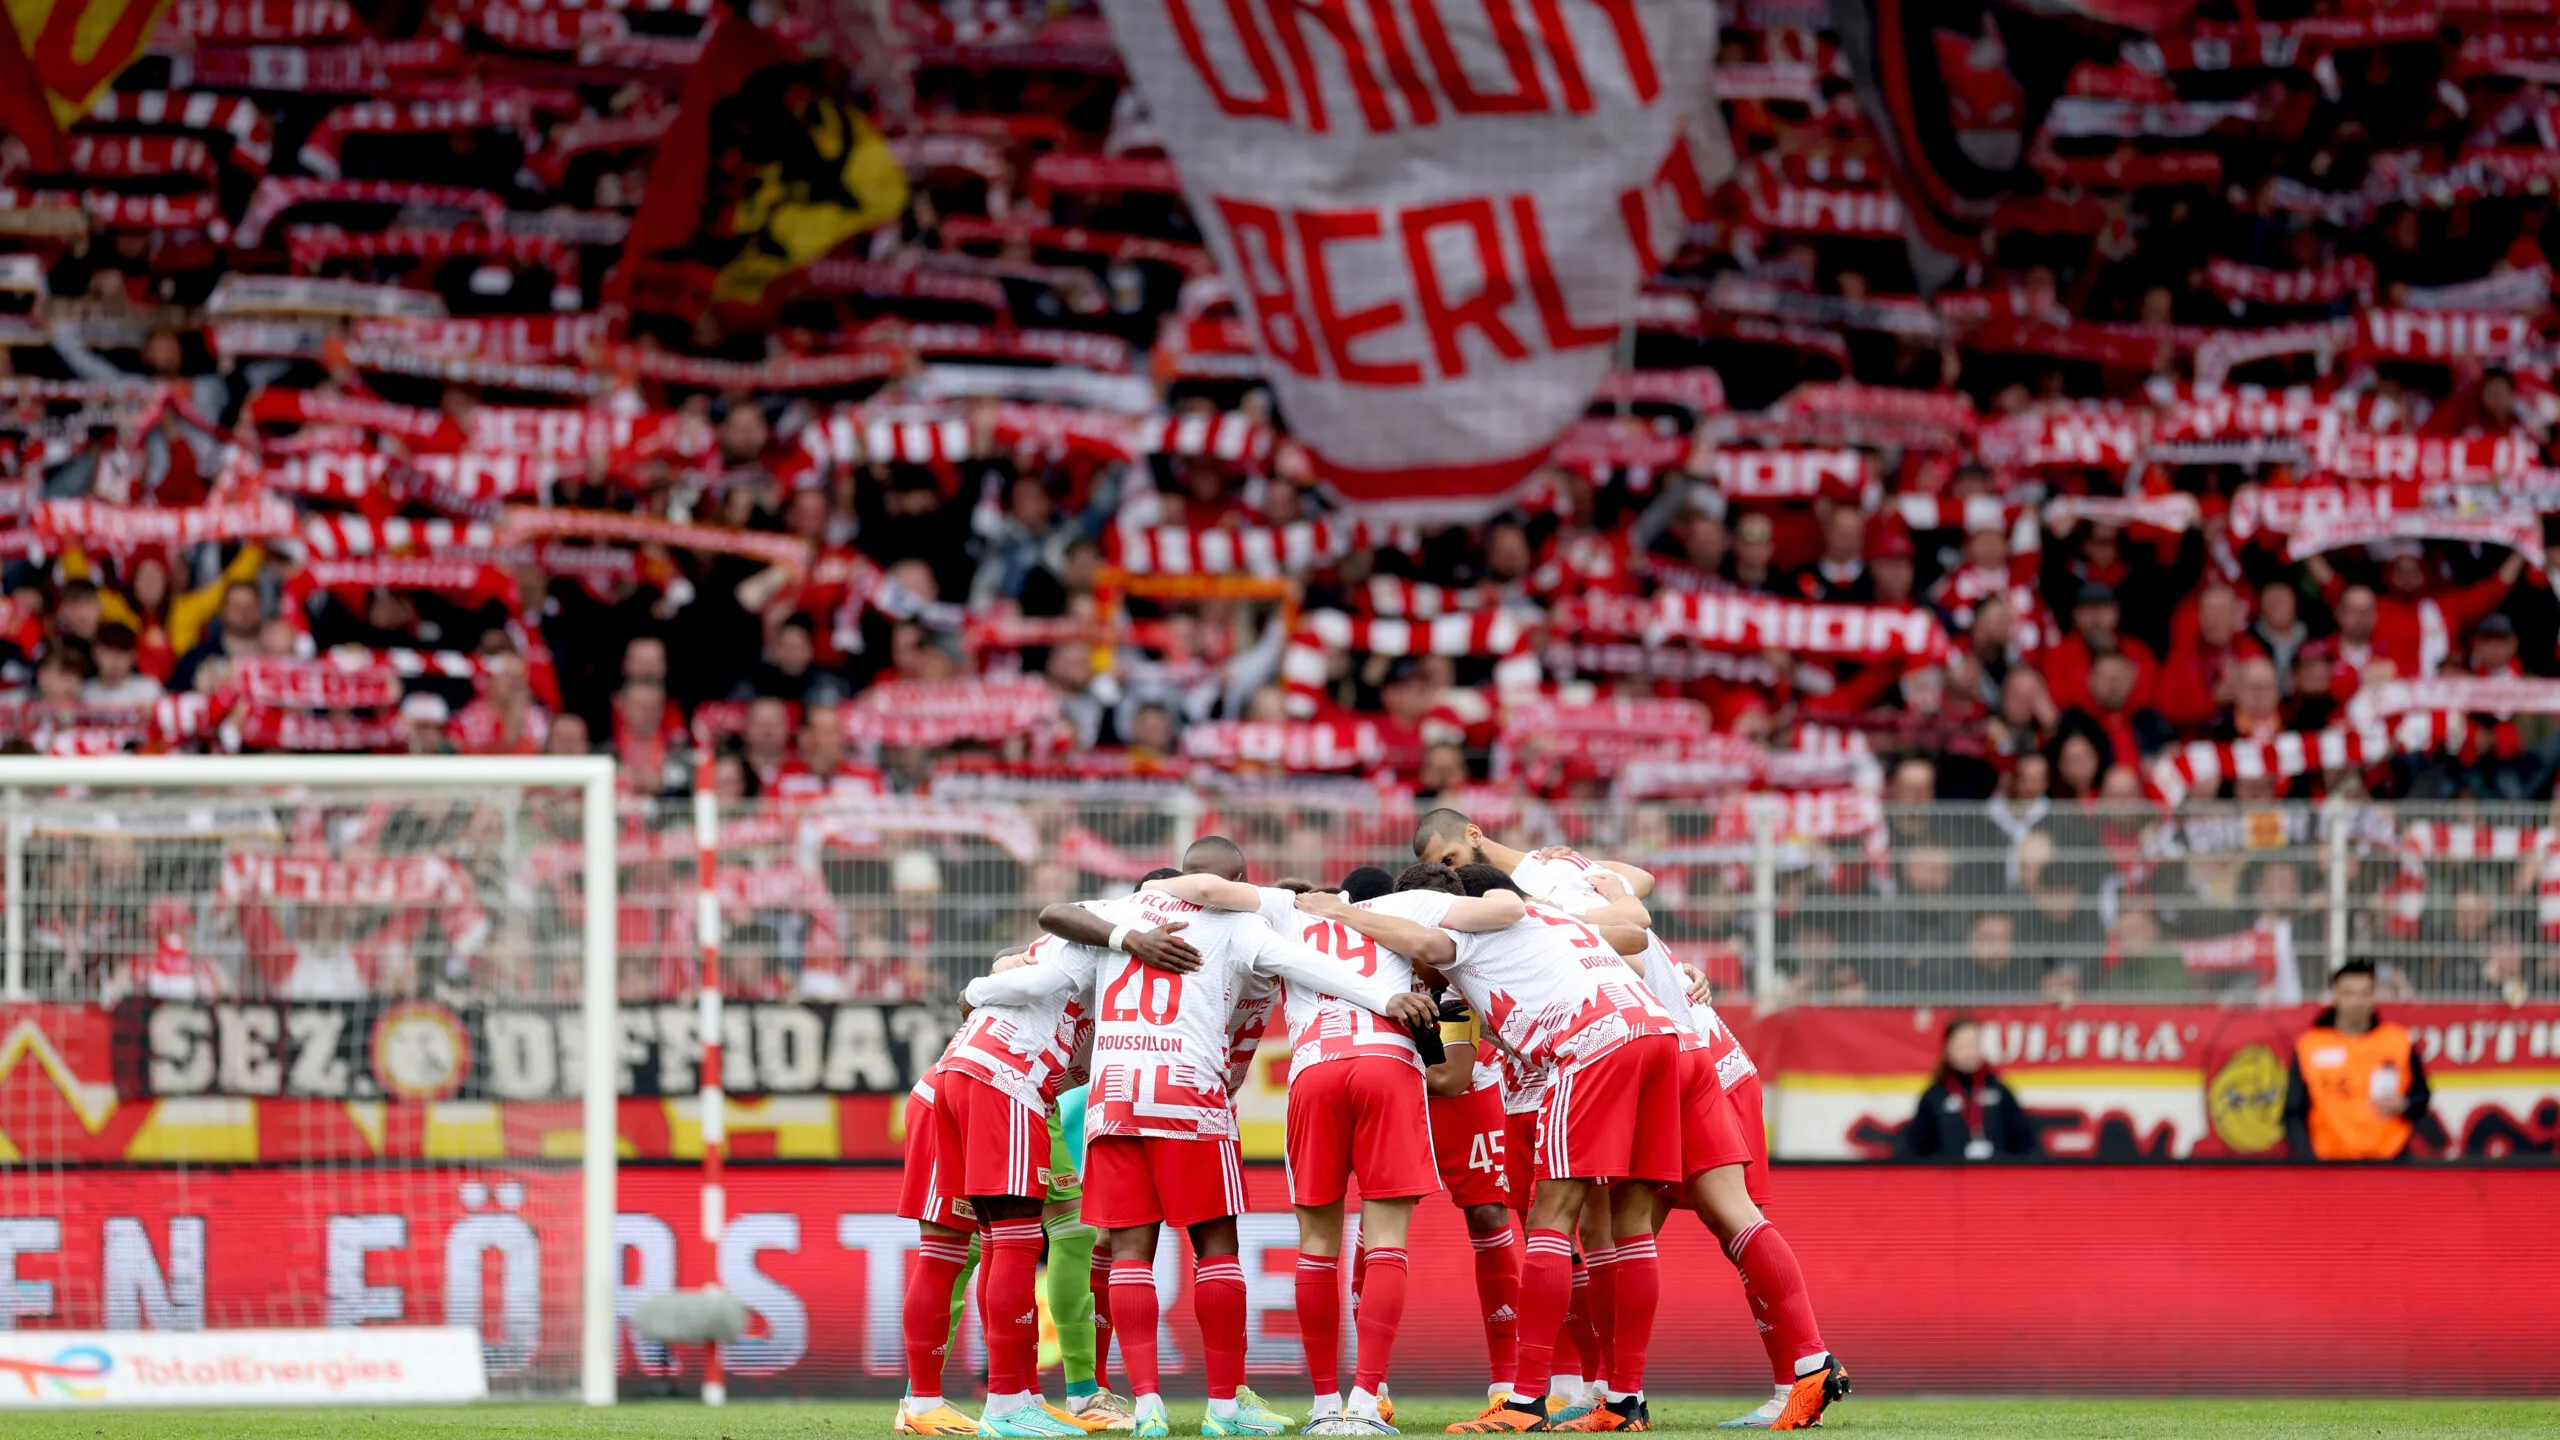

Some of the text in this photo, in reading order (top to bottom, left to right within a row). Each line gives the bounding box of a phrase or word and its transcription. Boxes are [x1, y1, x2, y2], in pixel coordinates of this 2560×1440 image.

[1164, 0, 1660, 132] UNION
[1140, 894, 1161, 910] FC
[1101, 936, 1184, 1027] 26
[1579, 956, 1625, 971] DOEKHI
[148, 1005, 372, 1098] SEZ.
[1097, 1034, 1184, 1054] ROUSSILLON
[1468, 1129, 1505, 1174] 45
[129, 1354, 404, 1388] TotalEnergies
